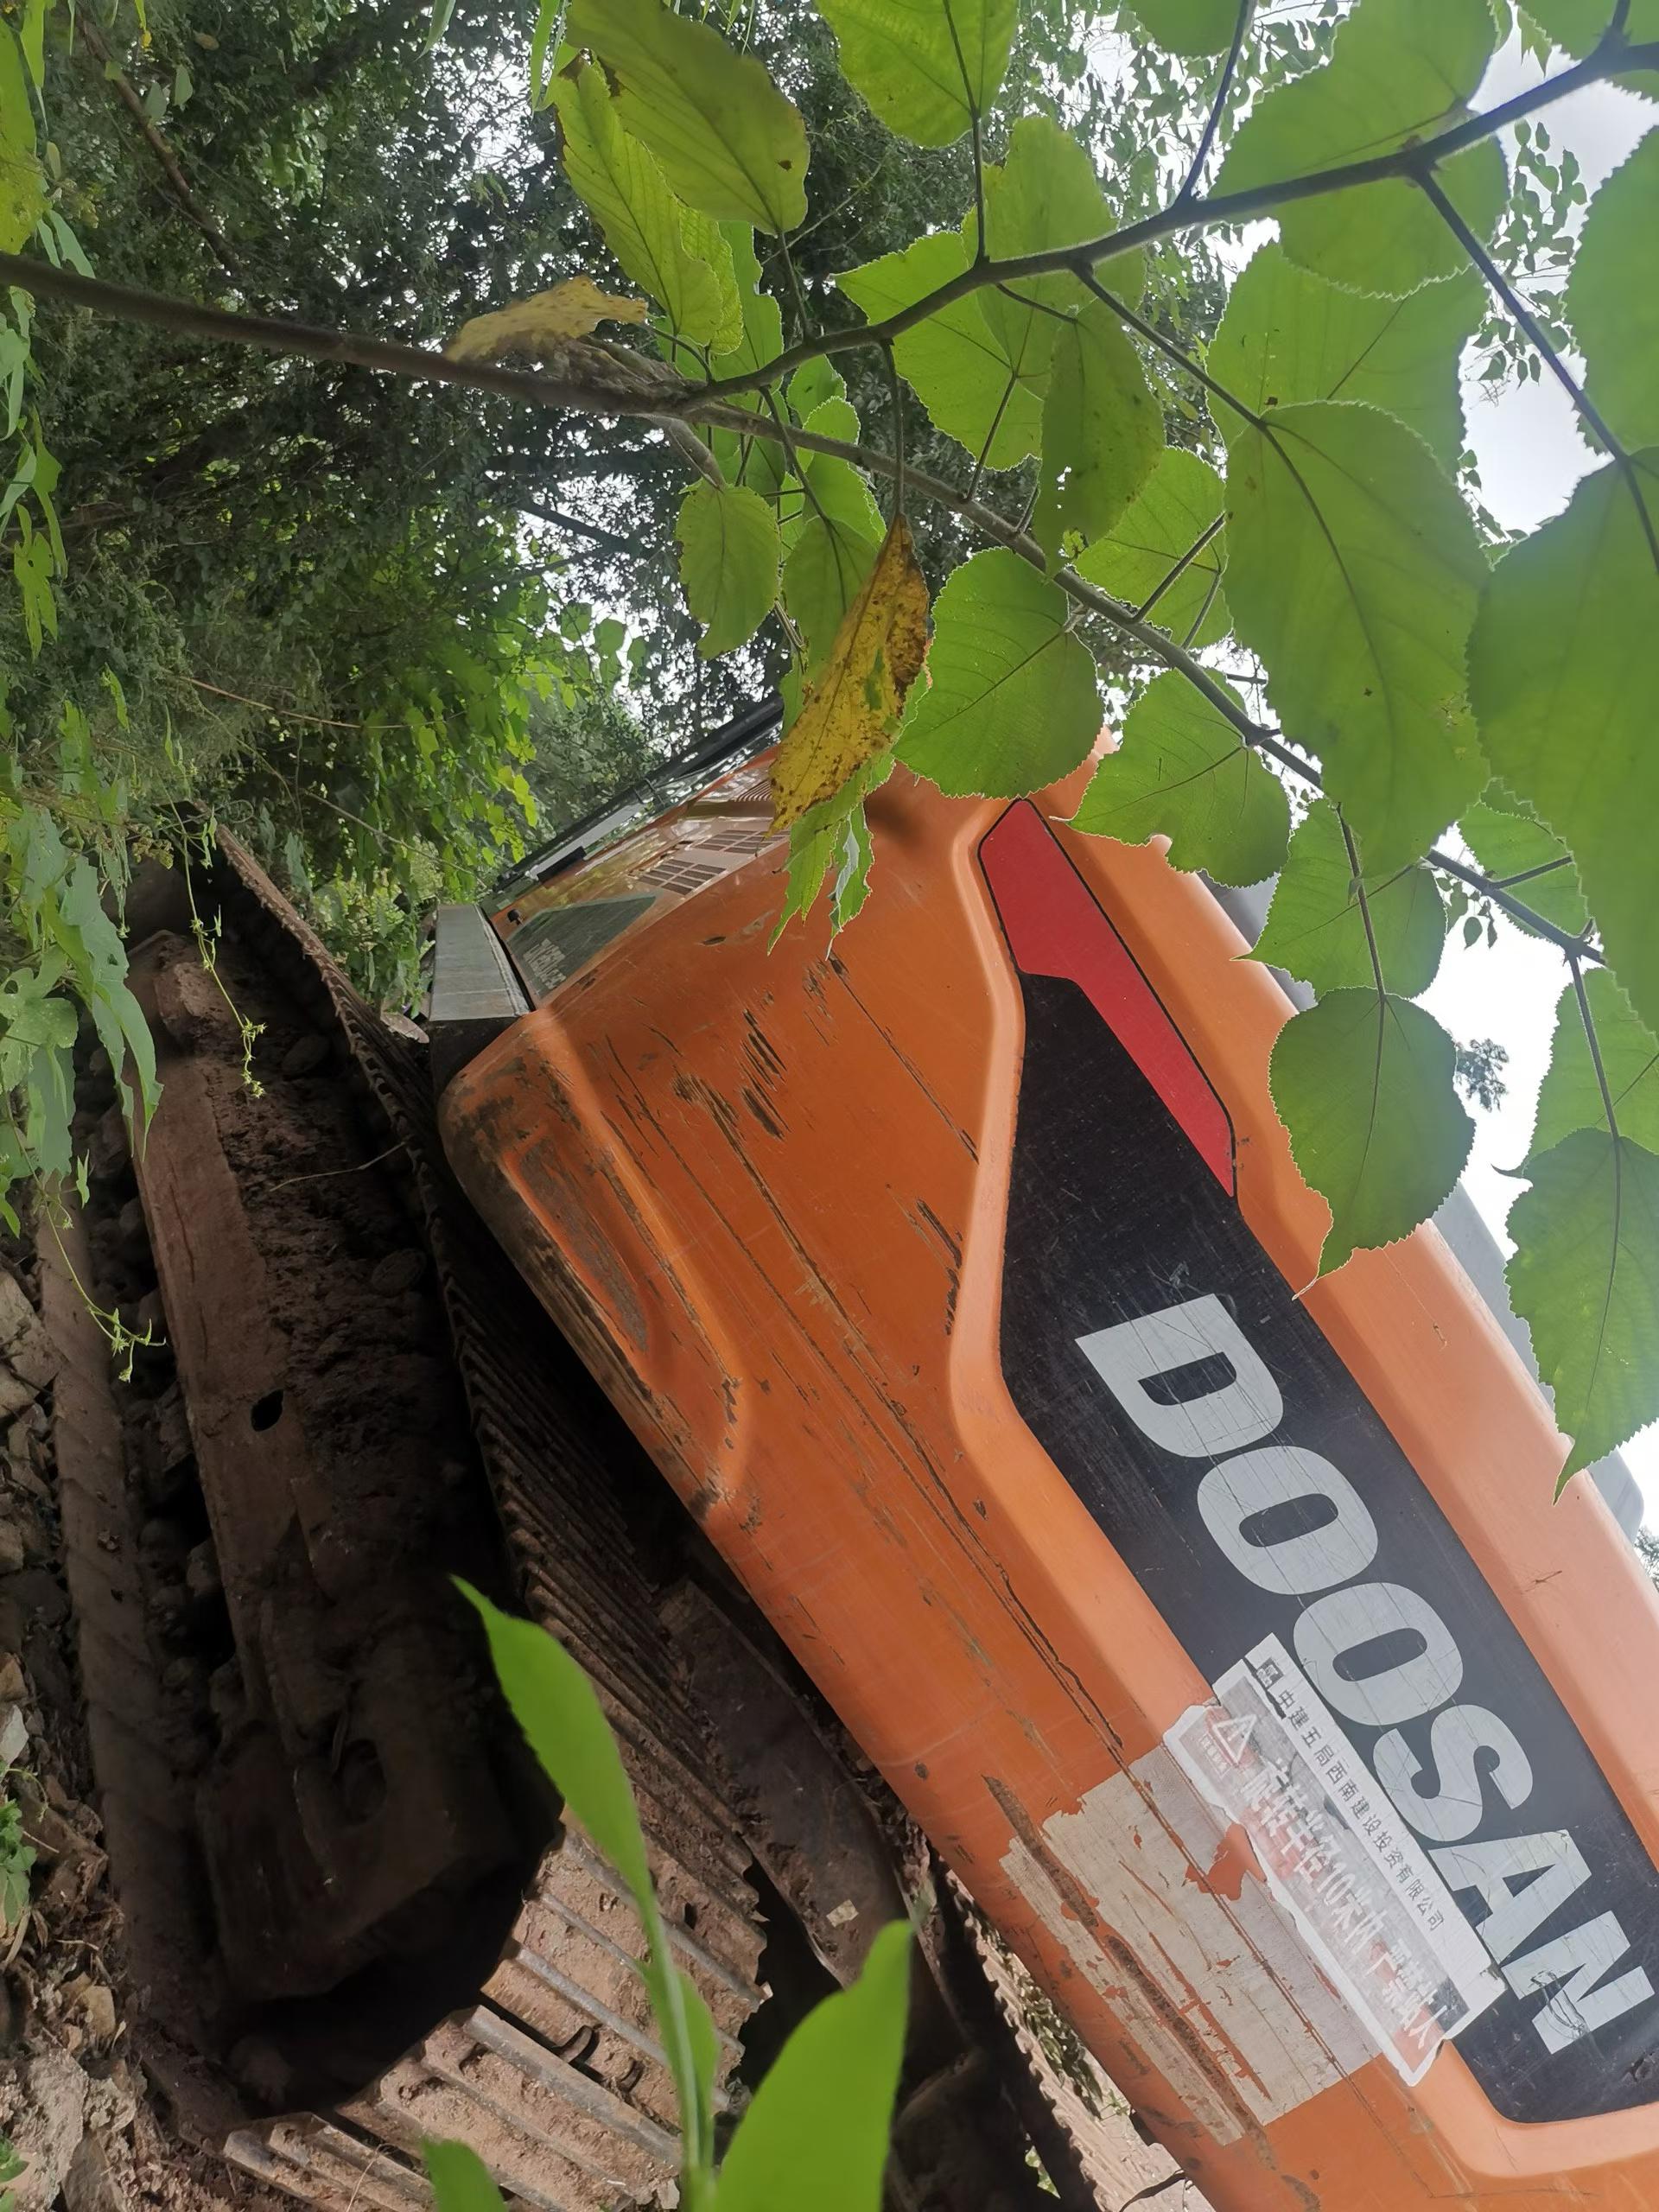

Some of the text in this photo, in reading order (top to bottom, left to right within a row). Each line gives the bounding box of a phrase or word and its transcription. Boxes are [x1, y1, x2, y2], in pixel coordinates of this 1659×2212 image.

[1075, 1294, 1654, 2054] DOOSAN
[1278, 1689, 1444, 1932] 中建五局西南建设投资有限公司
